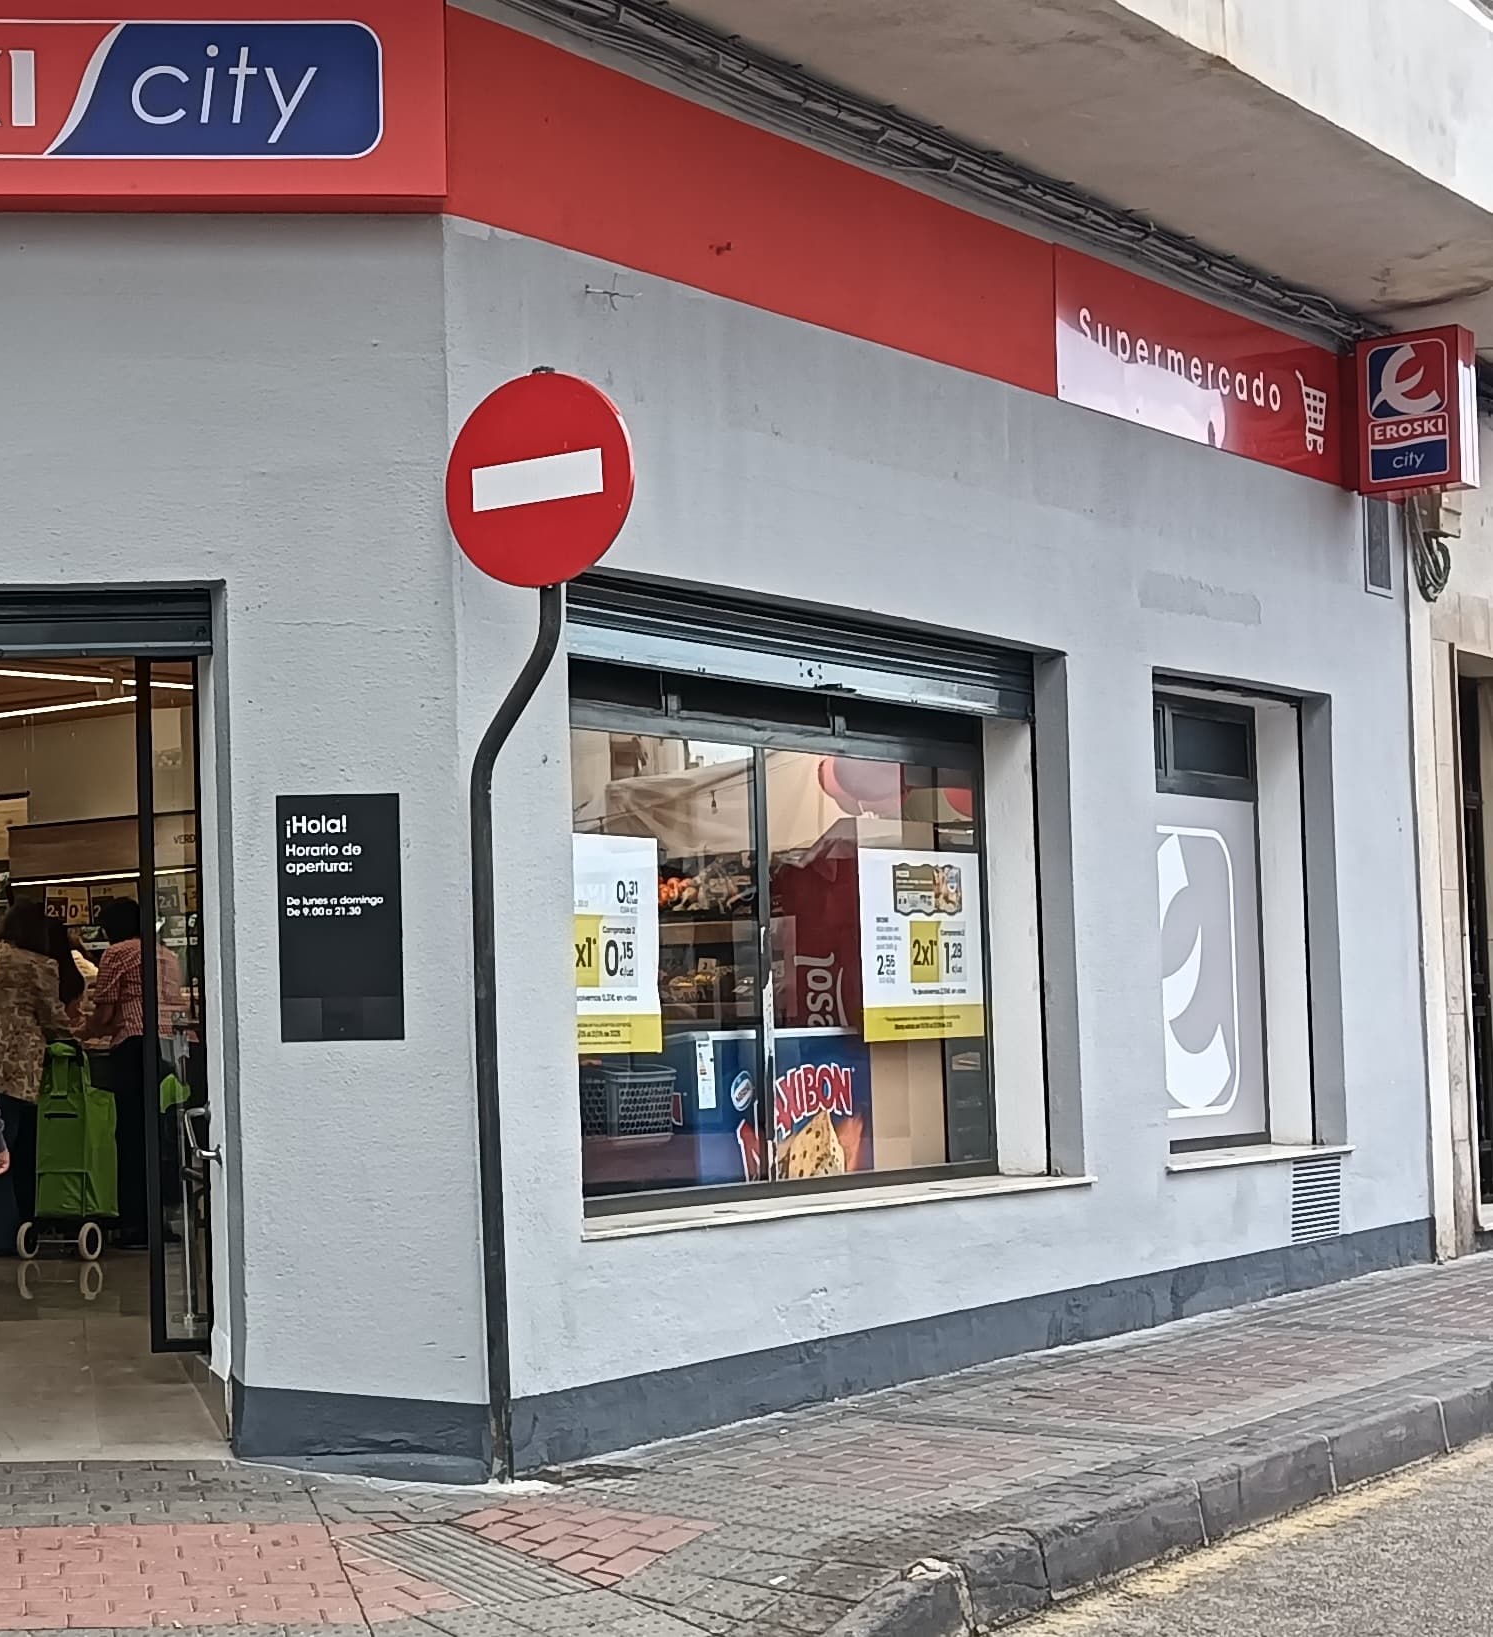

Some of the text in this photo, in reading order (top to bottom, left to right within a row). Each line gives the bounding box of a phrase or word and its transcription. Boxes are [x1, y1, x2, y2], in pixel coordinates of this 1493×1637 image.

[130, 43, 319, 144] city
[1078, 307, 1281, 413] Supermercado
[1374, 418, 1444, 440] EROSKI
[1392, 451, 1425, 469] city
[285, 814, 347, 839] ¡Hola!
[285, 842, 362, 857] Horario de
[285, 860, 353, 876] apertura:
[286, 896, 301, 906] De
[302, 895, 329, 905] lunes
[339, 895, 384, 907] domingo
[616, 880, 639, 904] 0,31
[286, 907, 301, 917] De
[302, 906, 325, 917] 9.00
[334, 905, 362, 916] 21.30
[604, 939, 634, 977] 0,15
